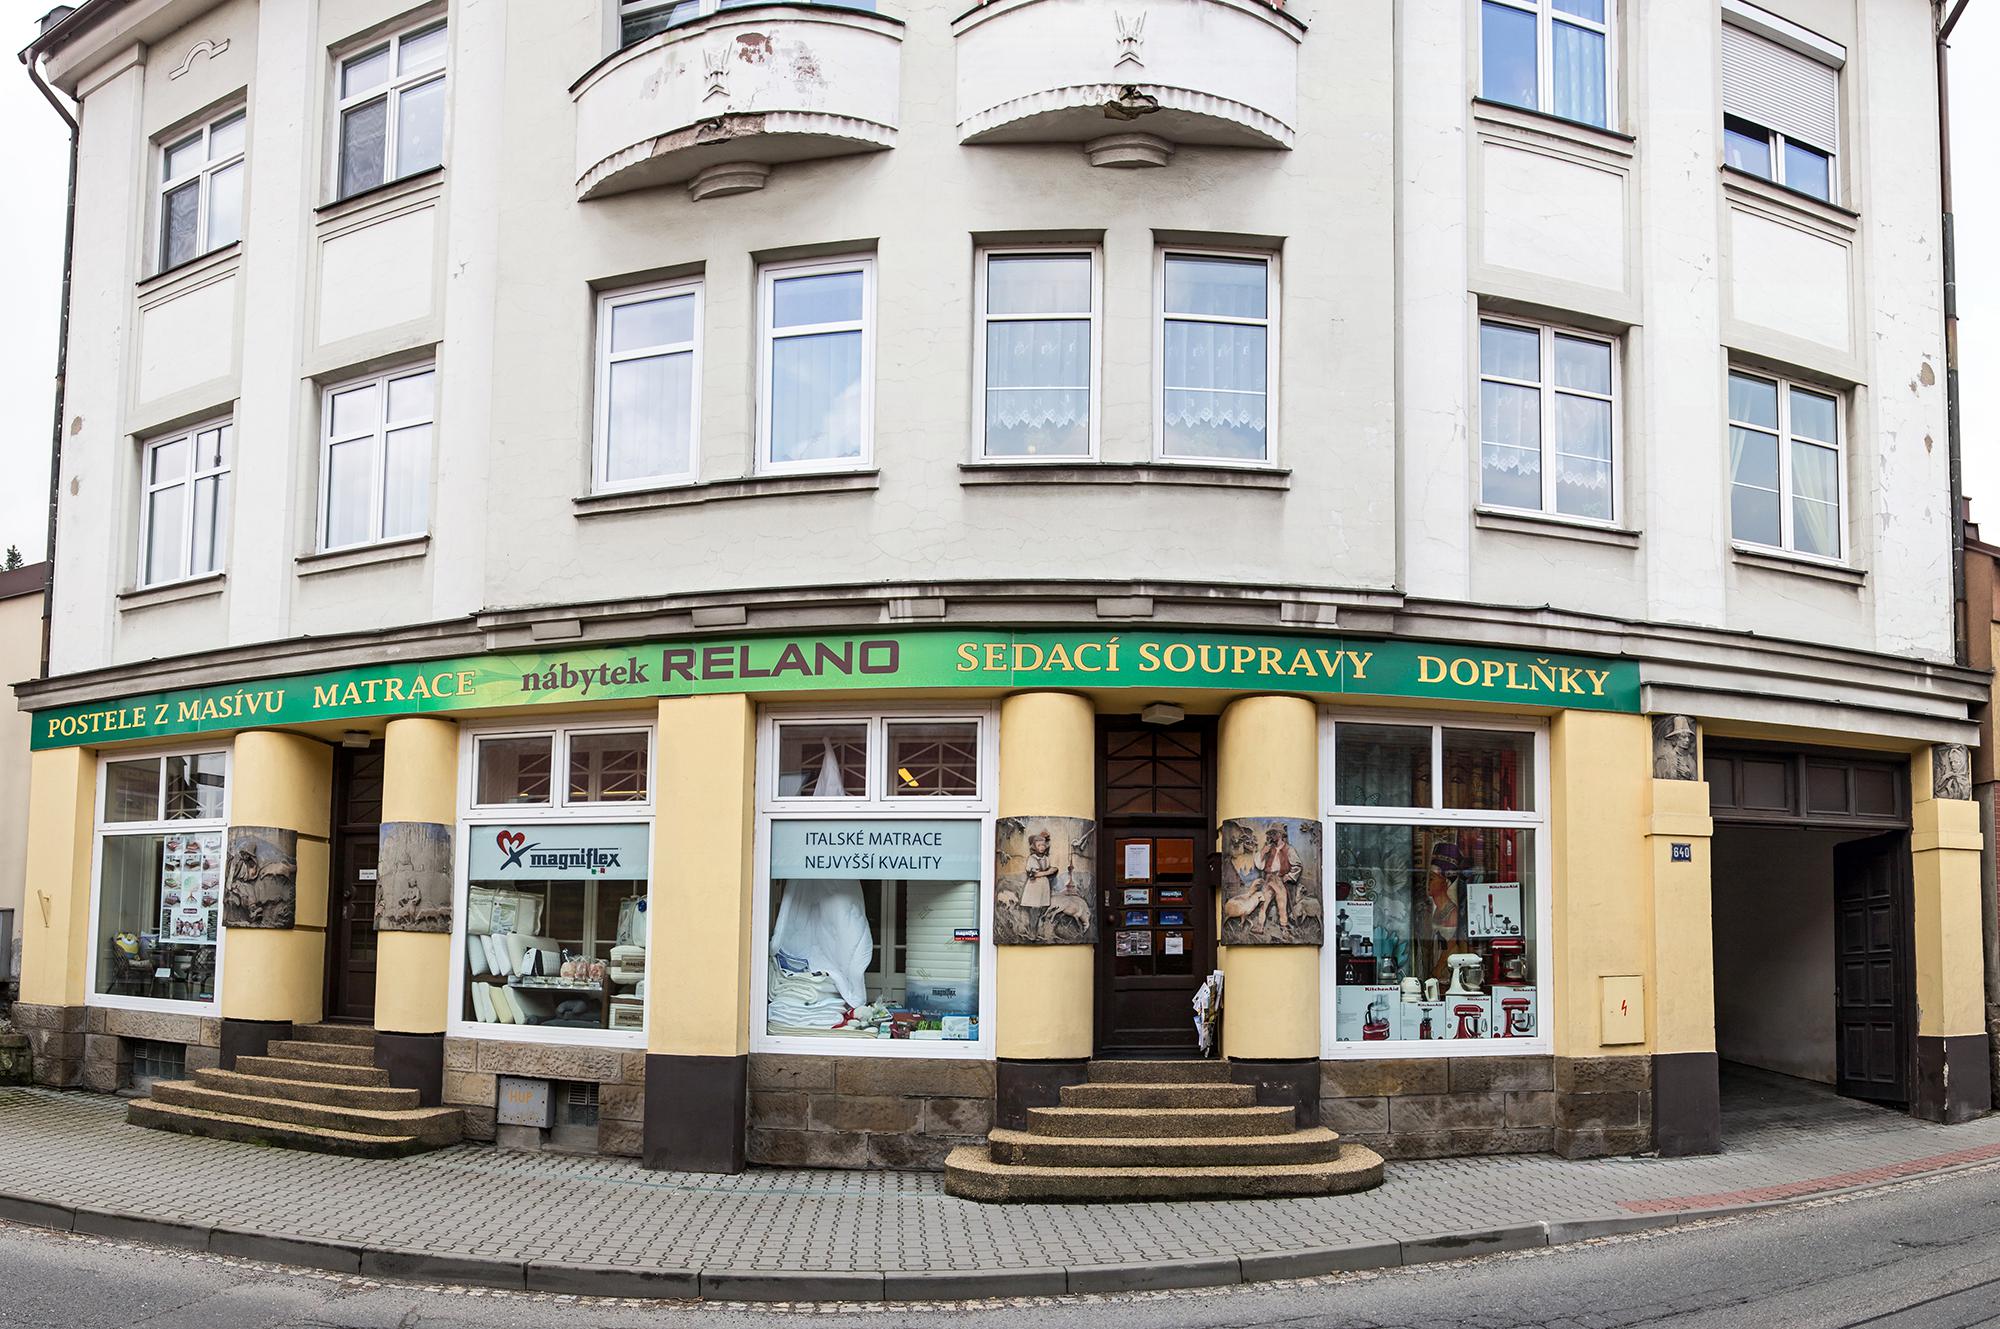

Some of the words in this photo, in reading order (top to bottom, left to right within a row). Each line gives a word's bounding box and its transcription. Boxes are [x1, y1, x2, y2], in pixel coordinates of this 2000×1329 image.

[520, 656, 650, 696] nábytek
[662, 640, 900, 682] RELANO
[956, 635, 1121, 673] SEDACÍ
[1138, 642, 1373, 679] SOUPRAVY
[1417, 655, 1610, 696] DOPLŇKY
[312, 669, 476, 709] MATRACE
[47, 706, 147, 738] POSTELE
[153, 703, 170, 725] Z
[177, 688, 286, 723] MASÍVU
[805, 829, 864, 846] ITALSKÉ
[869, 832, 942, 846] MATRACE
[1673, 847, 1690, 859] 640
[530, 847, 621, 871] magniflex
[805, 853, 875, 870] NEJVYŠŠÍ
[879, 855, 943, 870] KVALITY
